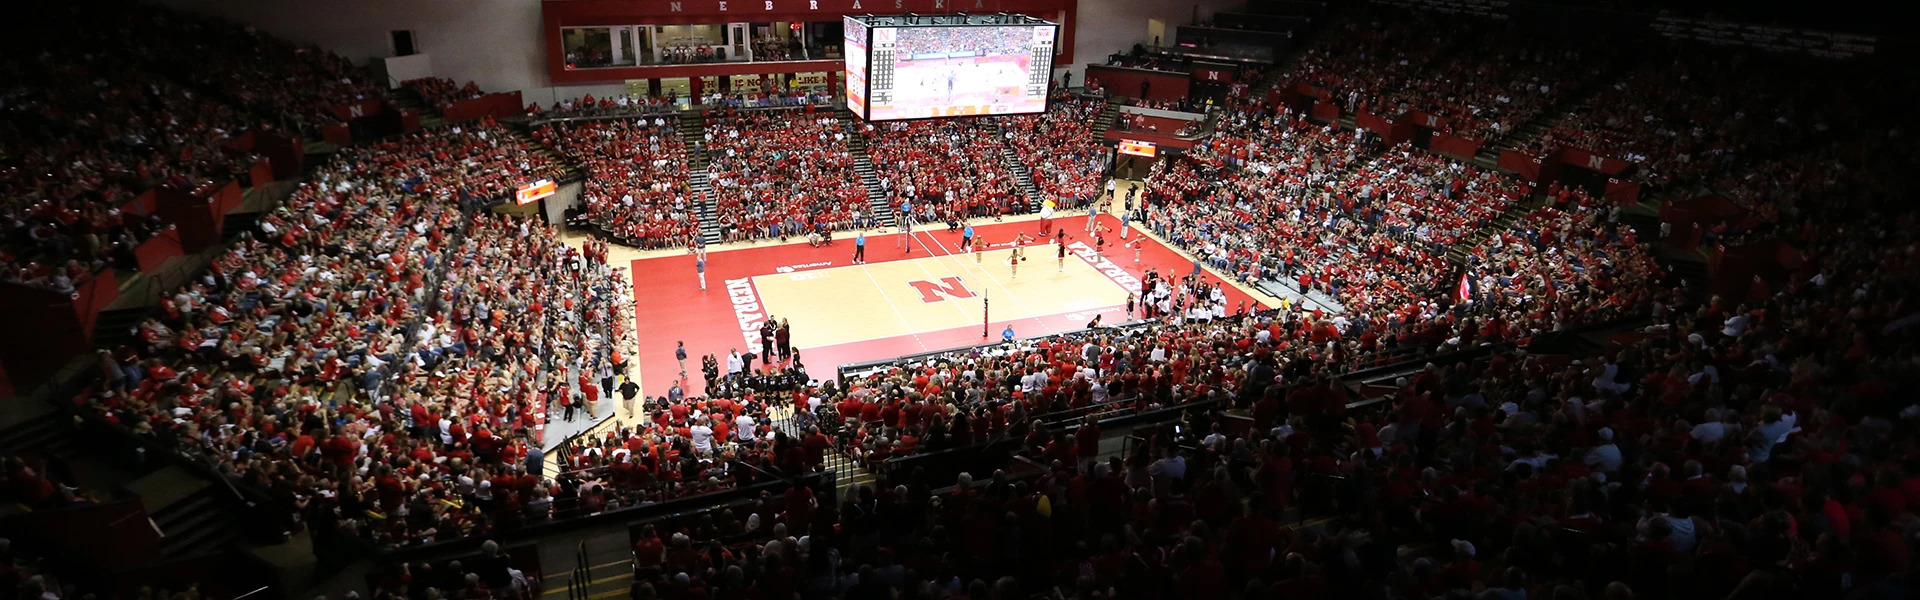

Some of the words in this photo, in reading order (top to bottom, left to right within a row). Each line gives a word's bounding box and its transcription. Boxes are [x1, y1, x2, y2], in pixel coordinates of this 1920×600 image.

[879, 29, 890, 40] N
[1208, 71, 1219, 80] N
[735, 79, 744, 87] IS
[350, 105, 363, 117] N
[1426, 115, 1438, 127] N
[1587, 155, 1604, 169] N
[1066, 240, 1143, 297] EBRASKA
[905, 274, 981, 304] N
